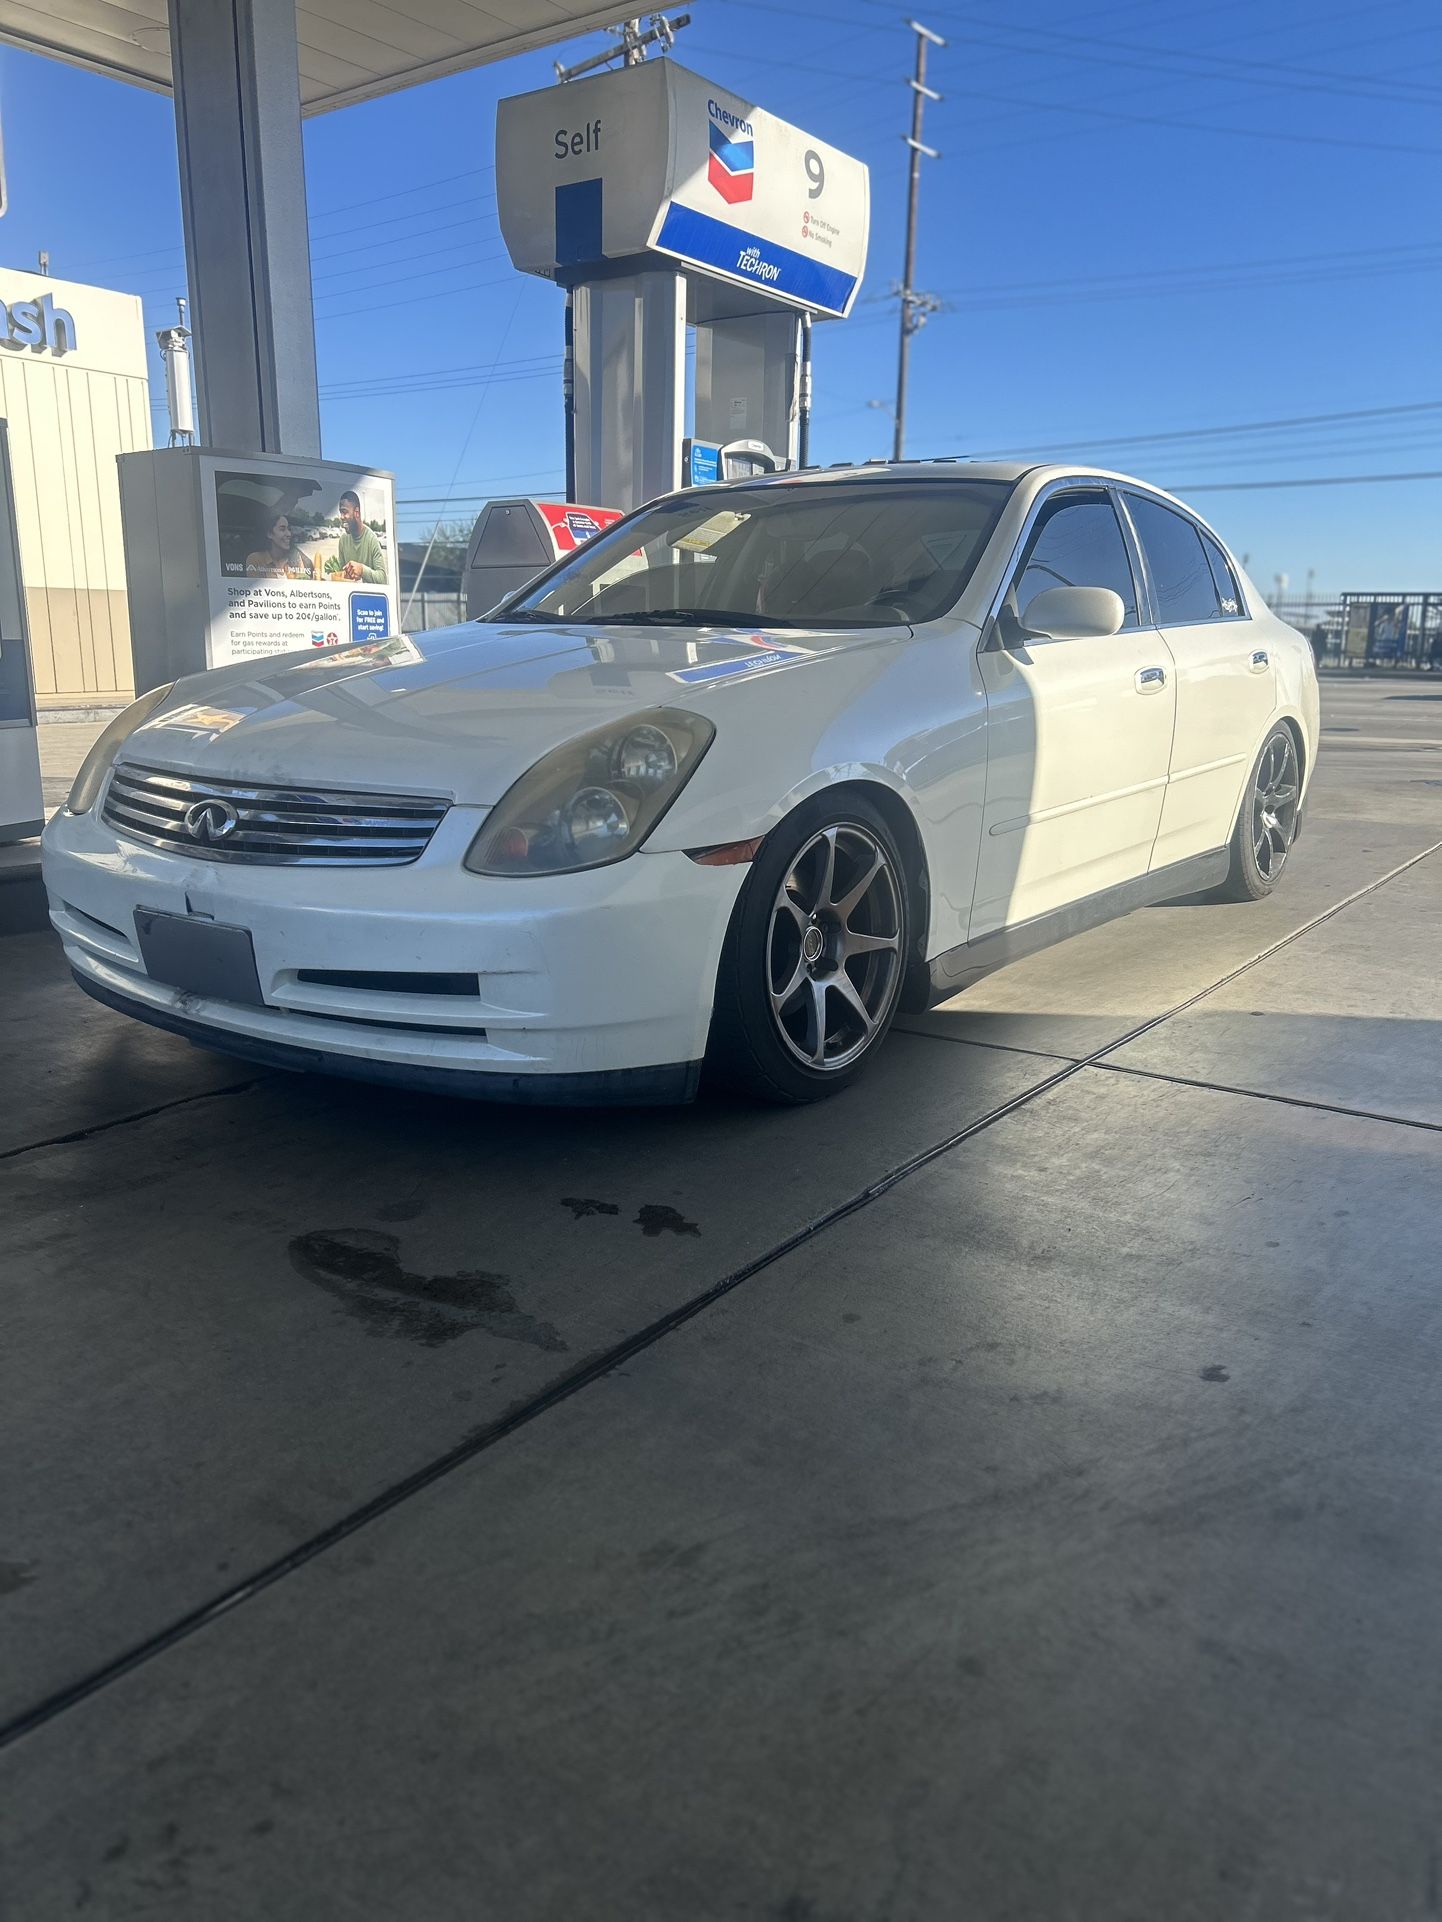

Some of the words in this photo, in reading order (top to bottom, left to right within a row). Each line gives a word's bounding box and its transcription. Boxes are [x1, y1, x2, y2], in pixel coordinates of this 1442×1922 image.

[707, 99, 753, 136] Chevron
[555, 119, 601, 159] Self
[804, 149, 825, 199] 9
[746, 246, 760, 259] with
[736, 250, 780, 281] TECHRON
[0, 292, 77, 351] sh
[226, 562, 244, 572] VONS
[227, 588, 250, 598] Shop
[264, 589, 288, 598] Vons,
[290, 590, 332, 600] Albertsons,
[228, 600, 245, 608] and
[248, 600, 286, 609] Pavilions
[288, 601, 296, 609] to
[318, 602, 341, 610] Points
[229, 611, 246, 619] and
[272, 613, 282, 622] up
[285, 612, 293, 620] to
